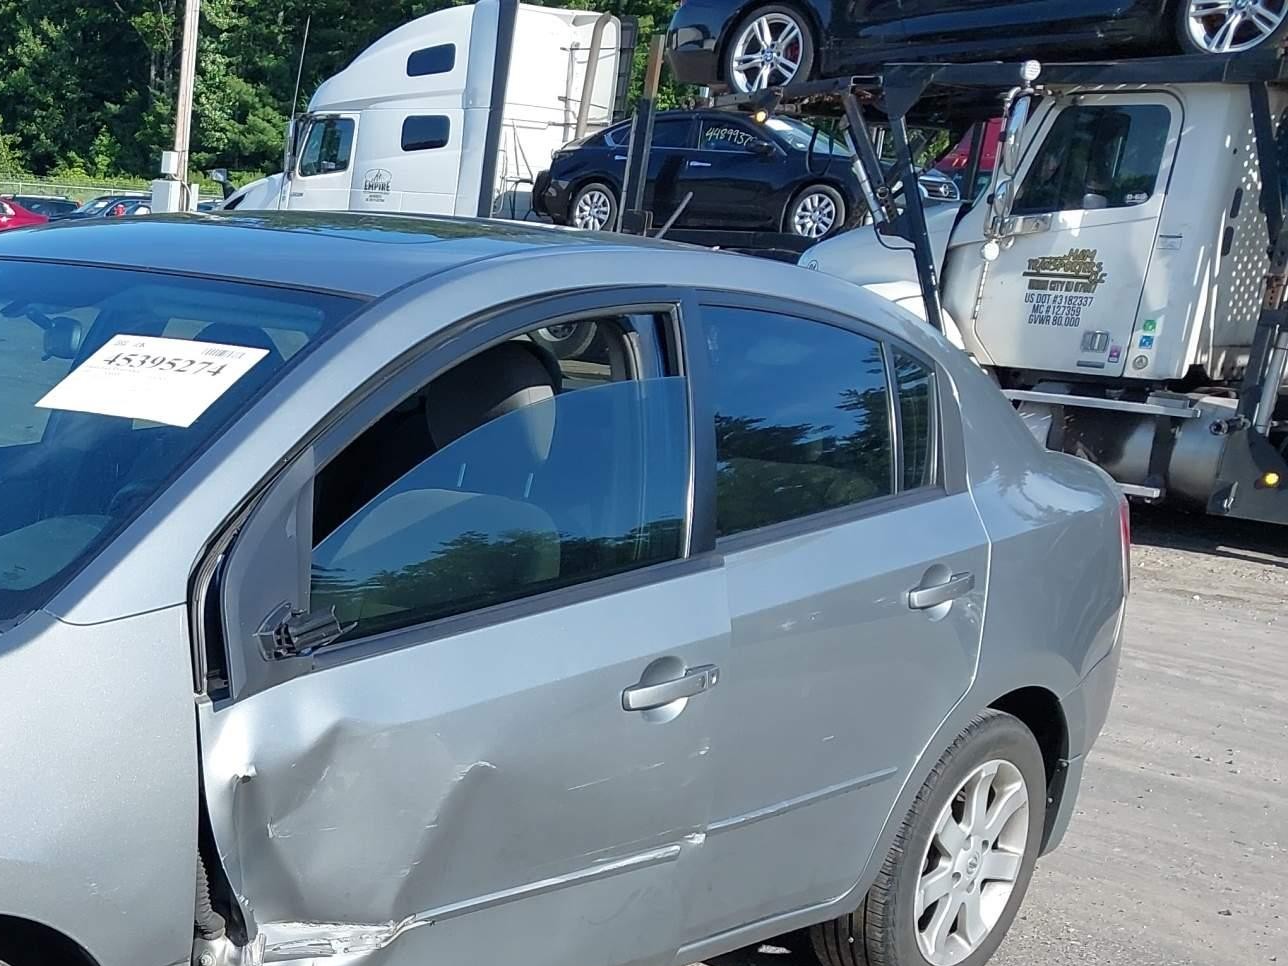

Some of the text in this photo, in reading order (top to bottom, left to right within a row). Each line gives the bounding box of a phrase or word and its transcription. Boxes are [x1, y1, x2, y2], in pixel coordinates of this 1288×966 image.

[363, 180, 391, 192] EMPIRE
[1024, 292, 1094, 307] US DOT #3182337
[1031, 304, 1045, 314] MC
[1028, 314, 1051, 325] GVWR
[103, 352, 228, 377] 45395274
